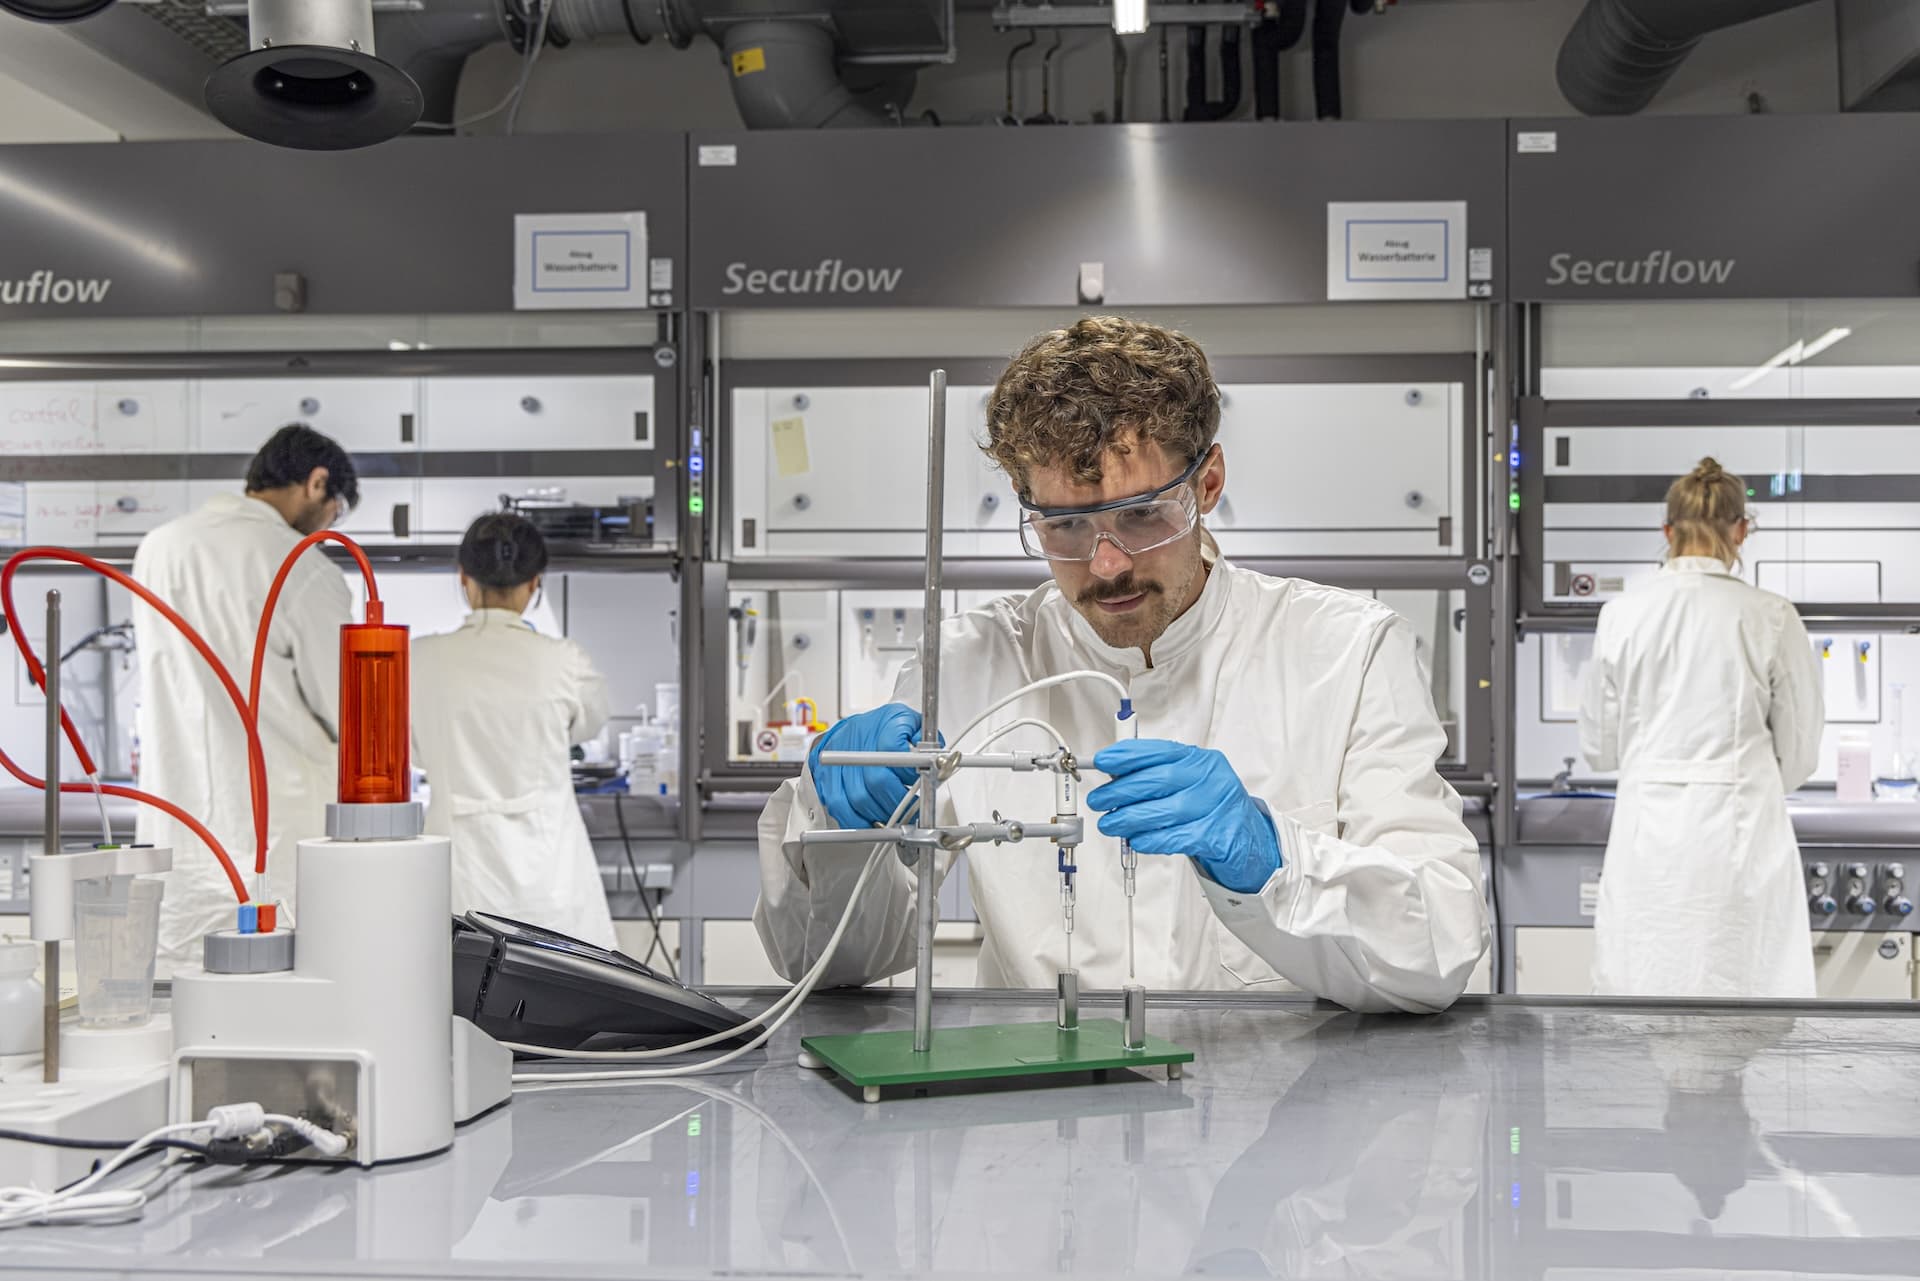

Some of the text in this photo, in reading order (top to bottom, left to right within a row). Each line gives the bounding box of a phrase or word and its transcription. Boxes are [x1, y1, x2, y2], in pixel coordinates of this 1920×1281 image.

[1358, 252, 1437, 263] Wasserbatterie
[1546, 250, 1736, 285] Secuflow
[0, 269, 112, 304] uflow
[722, 259, 903, 294] Secuflow
